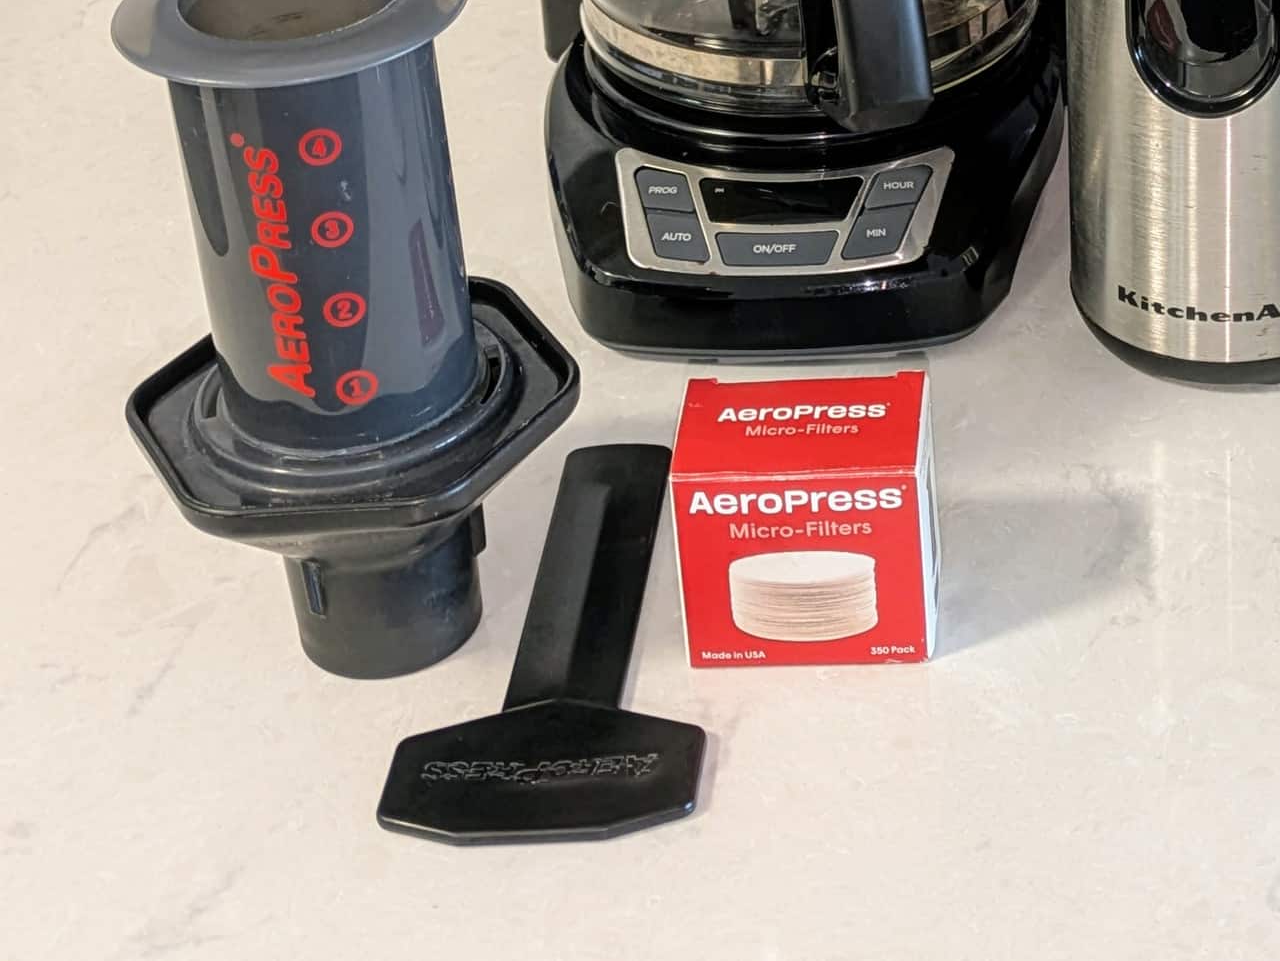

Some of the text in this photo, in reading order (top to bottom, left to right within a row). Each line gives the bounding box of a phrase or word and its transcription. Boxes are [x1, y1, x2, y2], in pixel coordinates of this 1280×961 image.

[312, 139, 327, 157] 4
[648, 185, 678, 196] PROG
[882, 179, 915, 190] HOUR
[324, 219, 340, 238] 3
[866, 227, 887, 239] MIN
[661, 231, 692, 243] AUTO
[752, 243, 797, 255] ON/OFF
[337, 299, 353, 320] 2
[717, 403, 887, 423] AeroPress
[745, 423, 859, 437] Micro-Filters
[688, 487, 903, 515] AeroPress
[728, 520, 873, 540] Micro-Filters
[701, 650, 732, 660] Made
[744, 649, 766, 659] USA
[869, 645, 915, 656] 350 Pack
